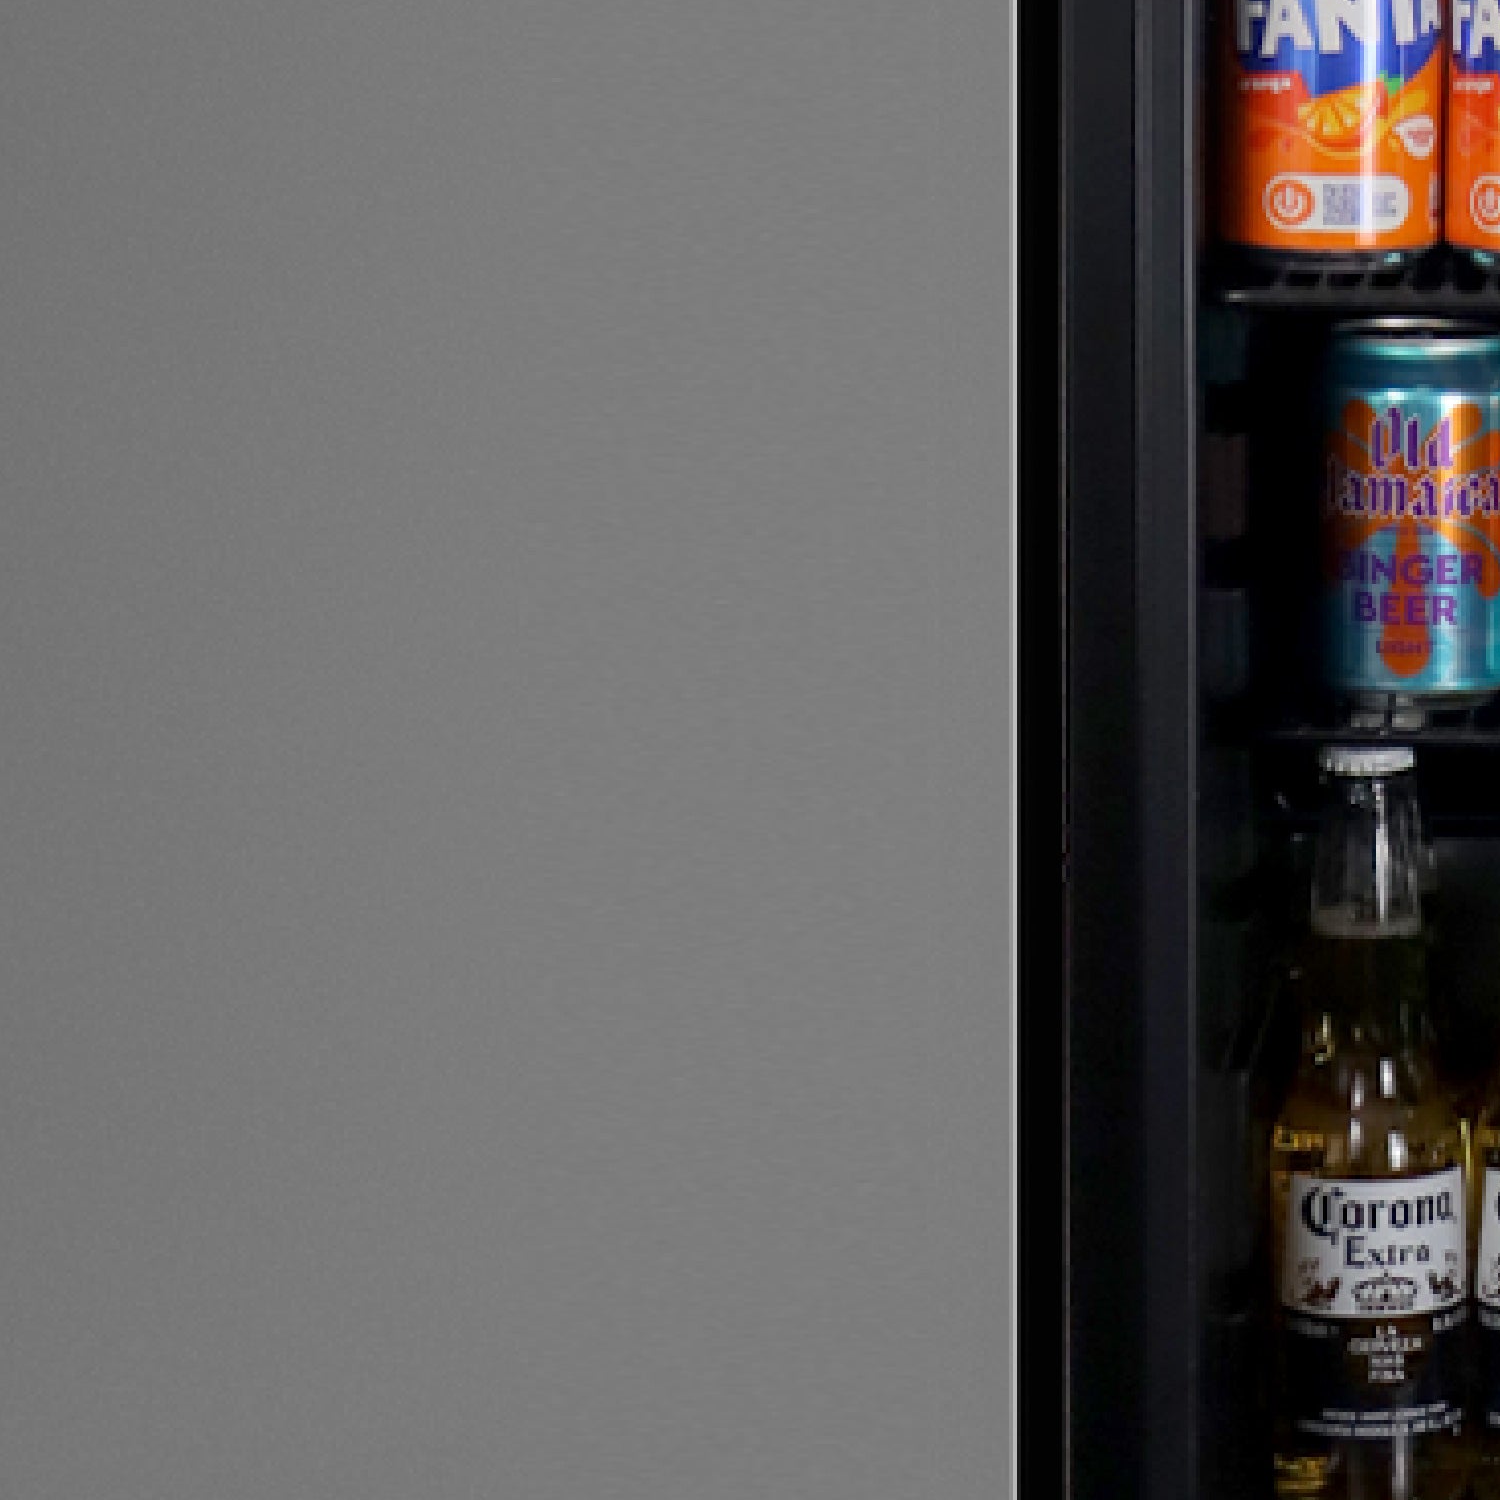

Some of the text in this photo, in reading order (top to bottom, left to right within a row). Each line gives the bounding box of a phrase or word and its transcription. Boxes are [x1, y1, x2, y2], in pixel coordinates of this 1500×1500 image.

[1370, 406, 1456, 470] Old
[1354, 591, 1458, 627] BEER
[1300, 1187, 1458, 1245] Corona
[1345, 1235, 1431, 1269] Extra
